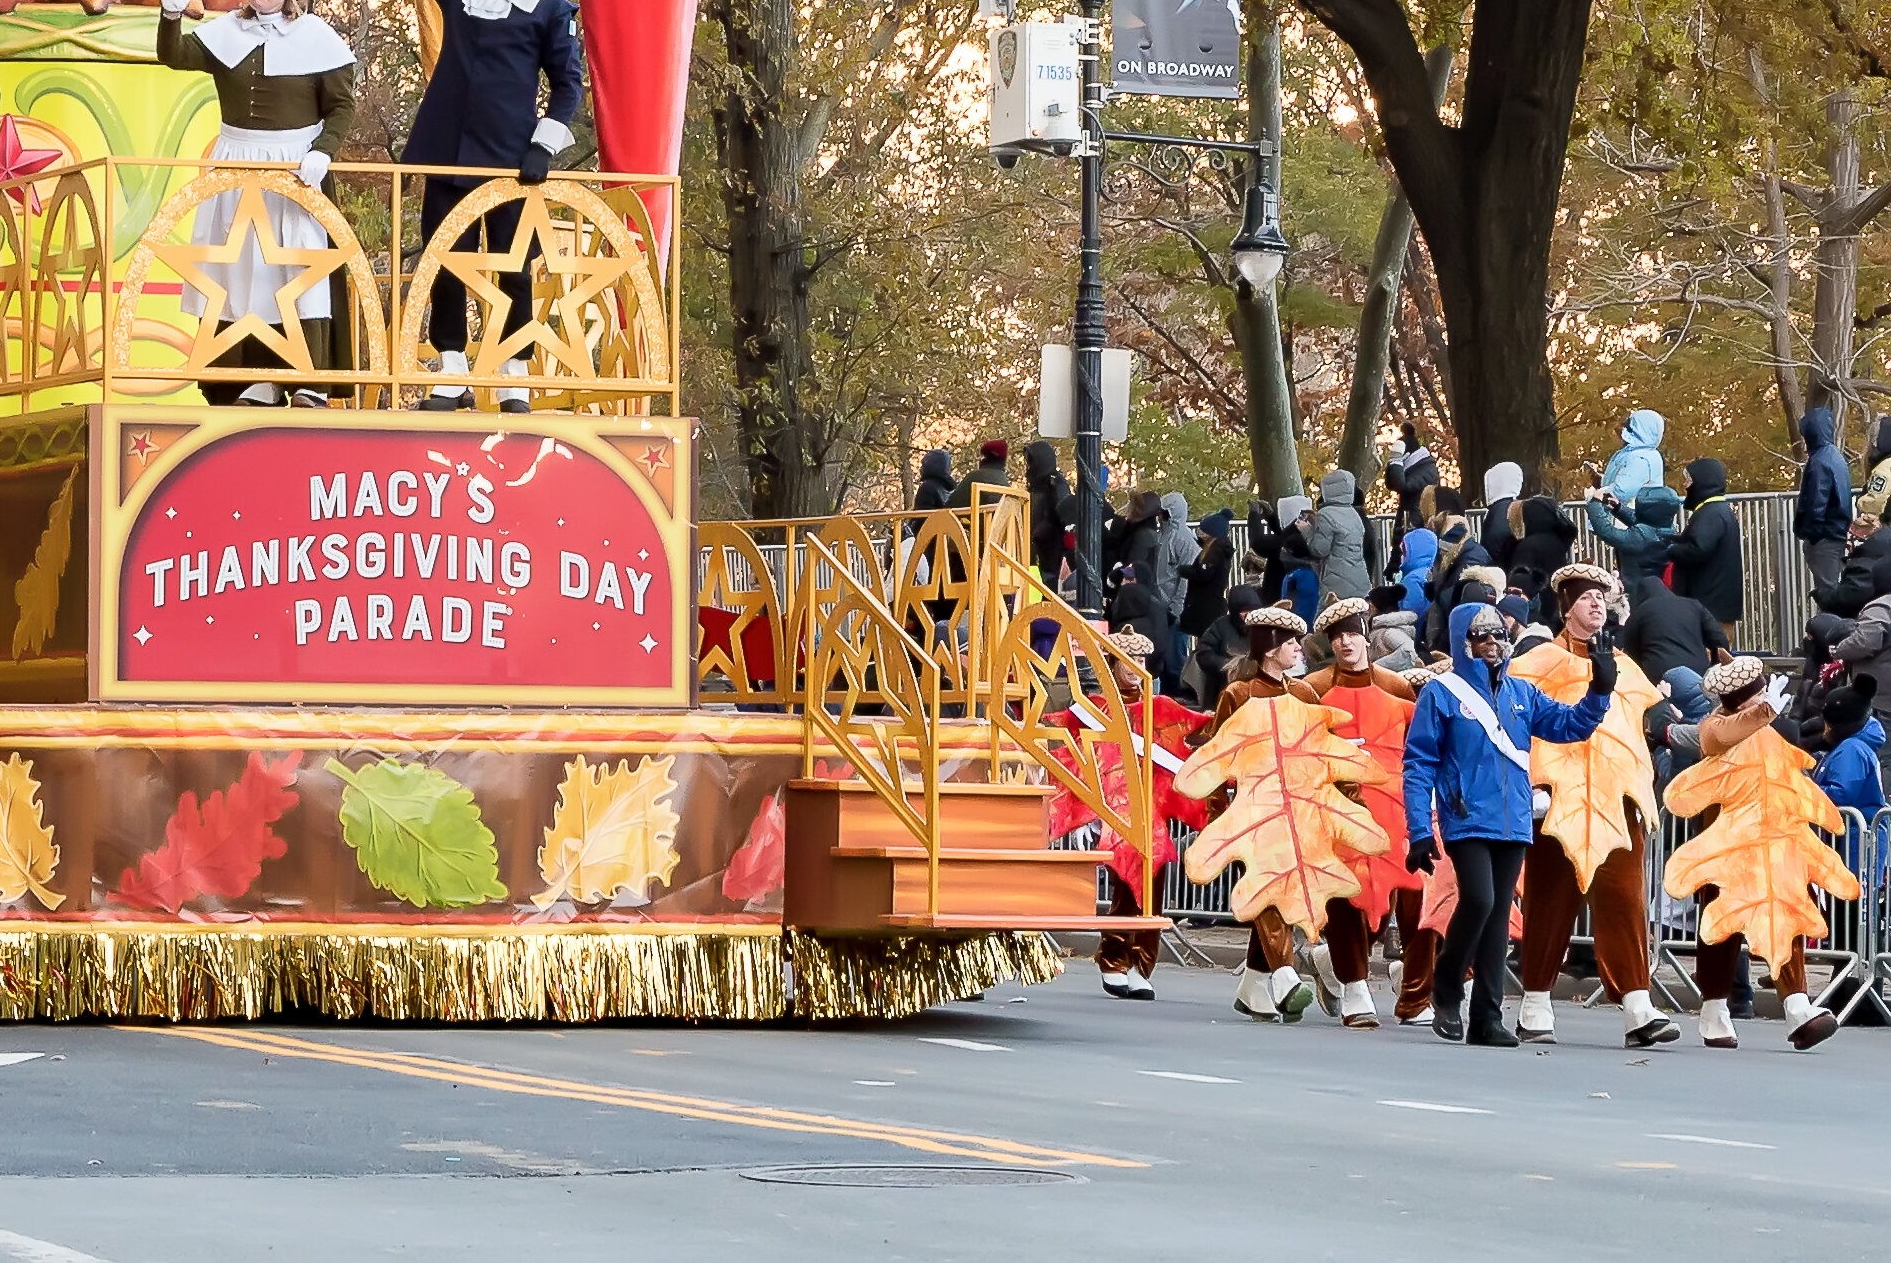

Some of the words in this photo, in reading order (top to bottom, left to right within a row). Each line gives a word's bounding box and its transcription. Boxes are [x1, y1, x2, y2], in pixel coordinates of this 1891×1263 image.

[1037, 64, 1073, 81] 71535
[1117, 60, 1142, 74] ON
[1147, 61, 1235, 78] BROADWAY
[145, 530, 532, 608] THANKSGIVING
[559, 550, 654, 615] DAY
[294, 594, 509, 649] PARADE
